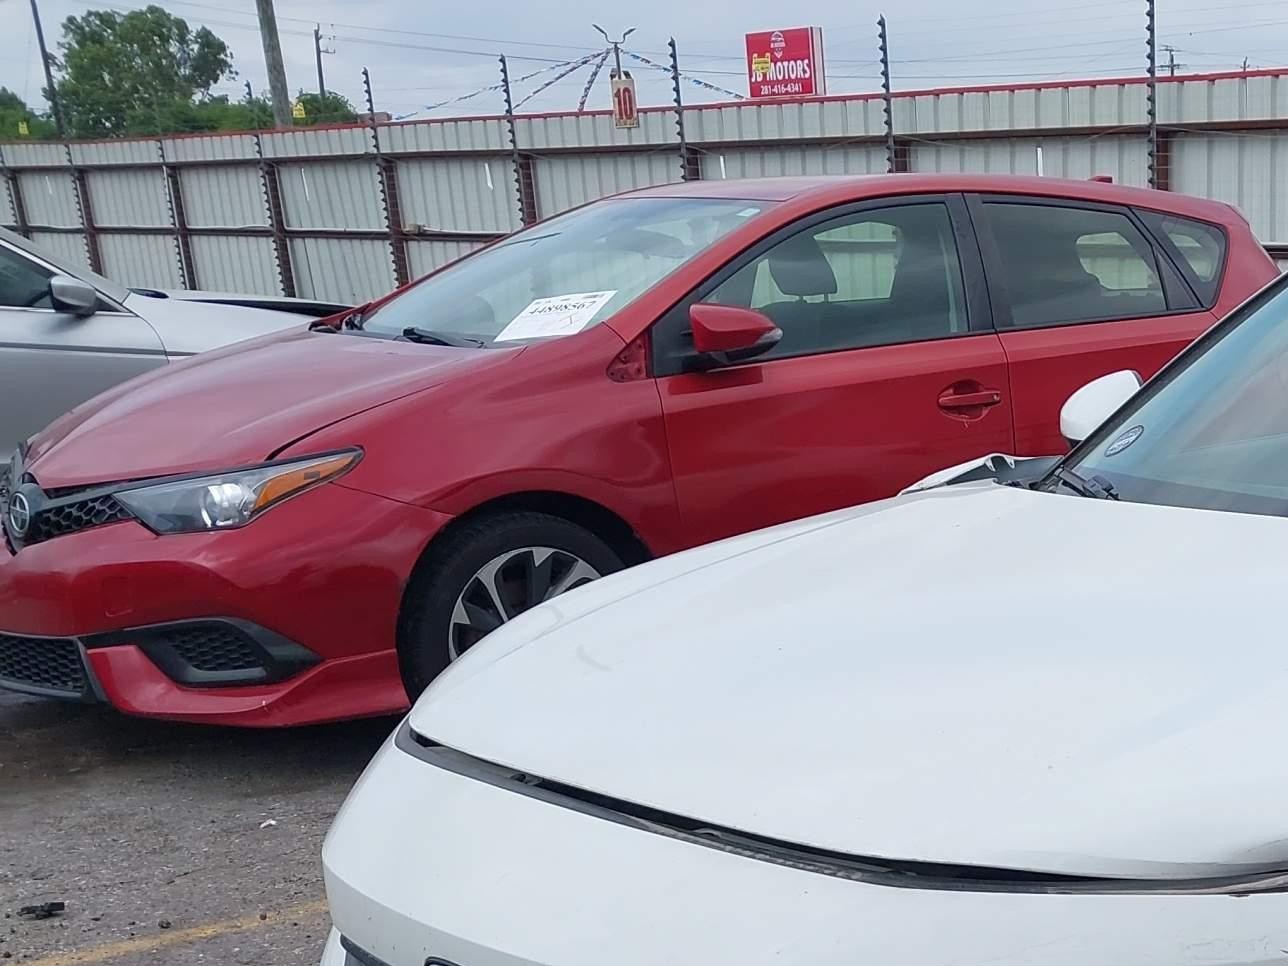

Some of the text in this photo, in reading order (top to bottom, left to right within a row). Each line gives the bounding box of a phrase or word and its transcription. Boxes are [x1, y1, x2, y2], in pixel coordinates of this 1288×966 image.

[767, 59, 811, 81] MOTORS
[760, 82, 803, 95] 281-416-4341
[614, 86, 634, 121] 10
